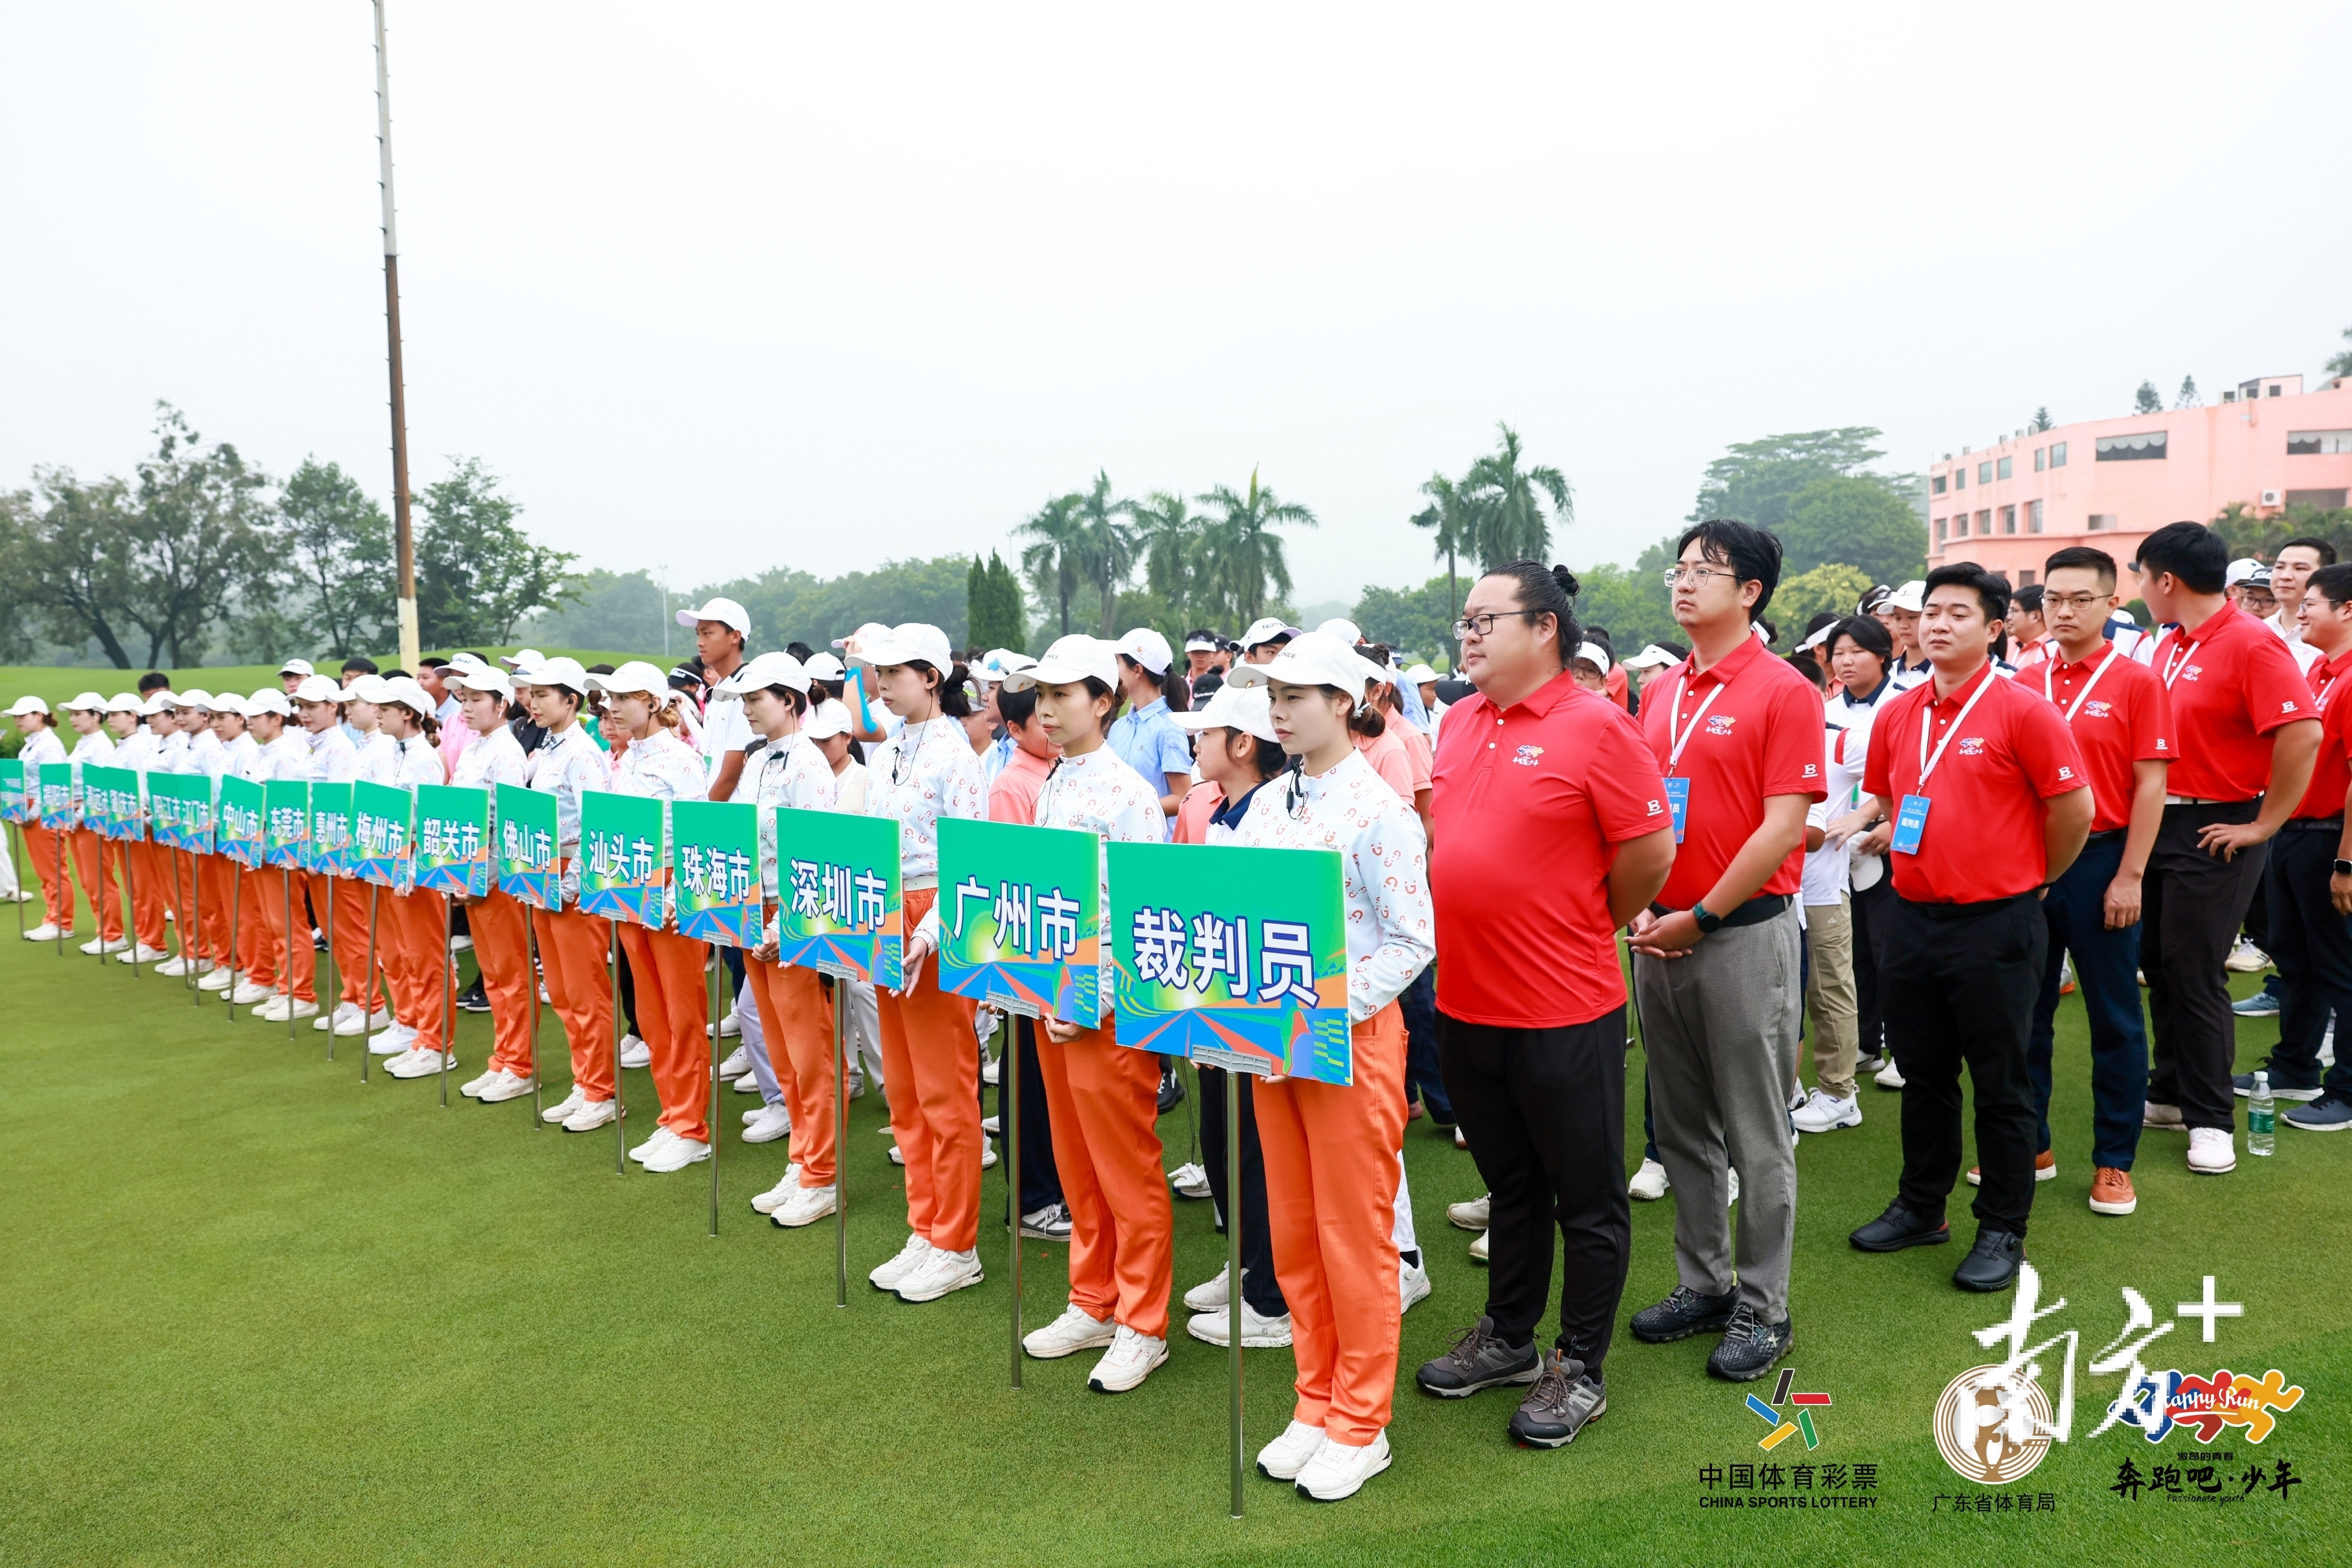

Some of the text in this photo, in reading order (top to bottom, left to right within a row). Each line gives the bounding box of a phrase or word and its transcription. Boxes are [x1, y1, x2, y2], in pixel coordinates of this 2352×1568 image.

[182, 799, 209, 829] 江门市
[223, 801, 259, 840] 中山市
[270, 807, 305, 839] 东莞市
[315, 811, 348, 845] 惠州市
[355, 811, 404, 857] 梅州市
[423, 816, 480, 861] 韶关市
[503, 819, 552, 872] 佛山市
[587, 829, 655, 885] 汕头市
[1315, 841, 1339, 851] GIONEE
[681, 844, 751, 902] 珠海市
[788, 857, 887, 932] 深圳市
[952, 874, 1081, 961] 广州市
[1132, 906, 1321, 1009] 裁判员
